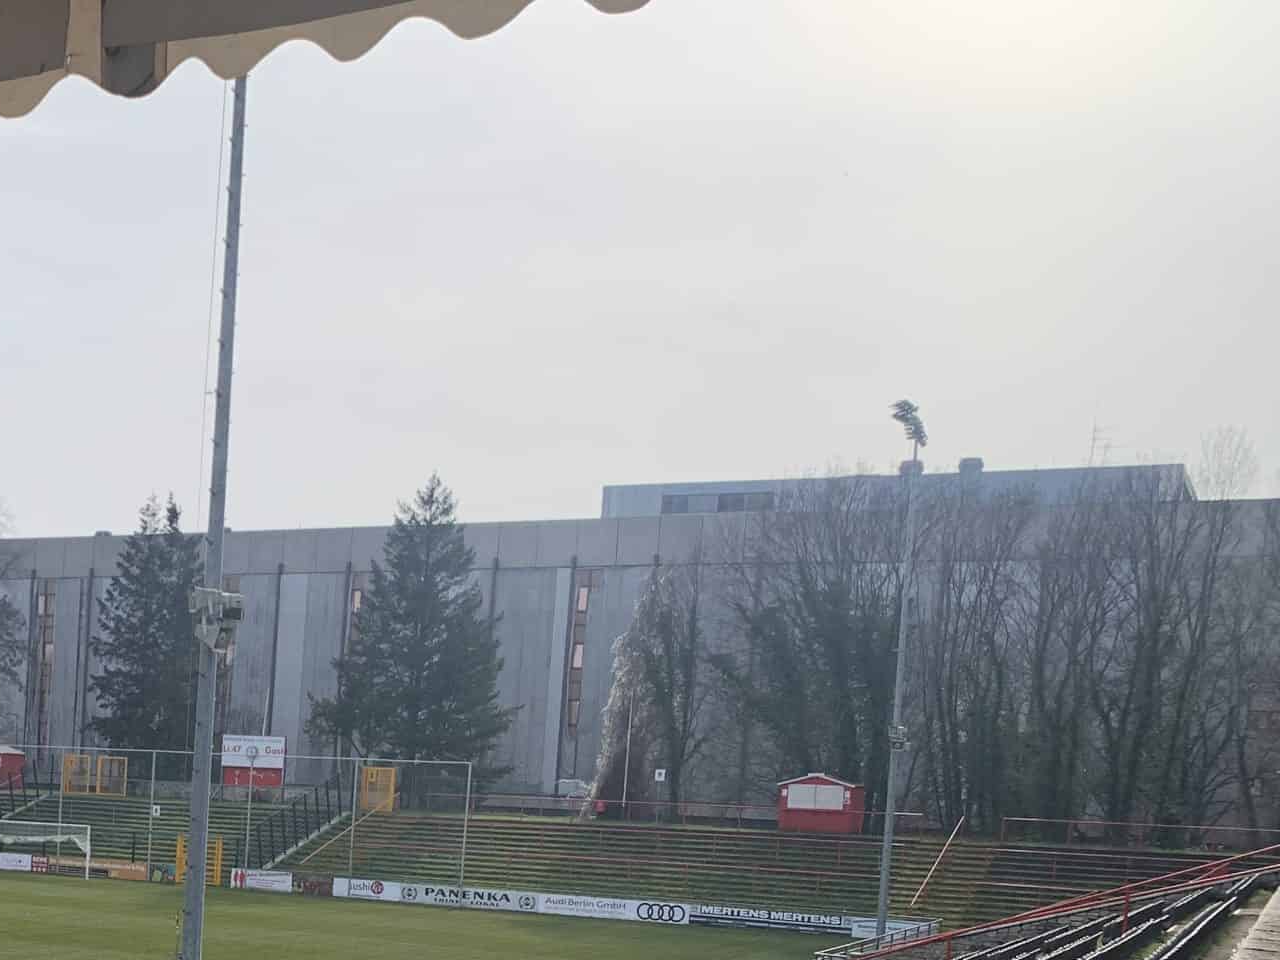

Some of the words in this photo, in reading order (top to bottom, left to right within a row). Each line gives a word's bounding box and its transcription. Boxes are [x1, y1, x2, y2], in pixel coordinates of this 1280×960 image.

[424, 887, 511, 903] PANENKA
[545, 897, 567, 905] Audi
[568, 898, 594, 908] Berlin
[596, 901, 626, 910] GmbH
[701, 905, 769, 919] MERTENS
[770, 912, 841, 925] MERTENS
